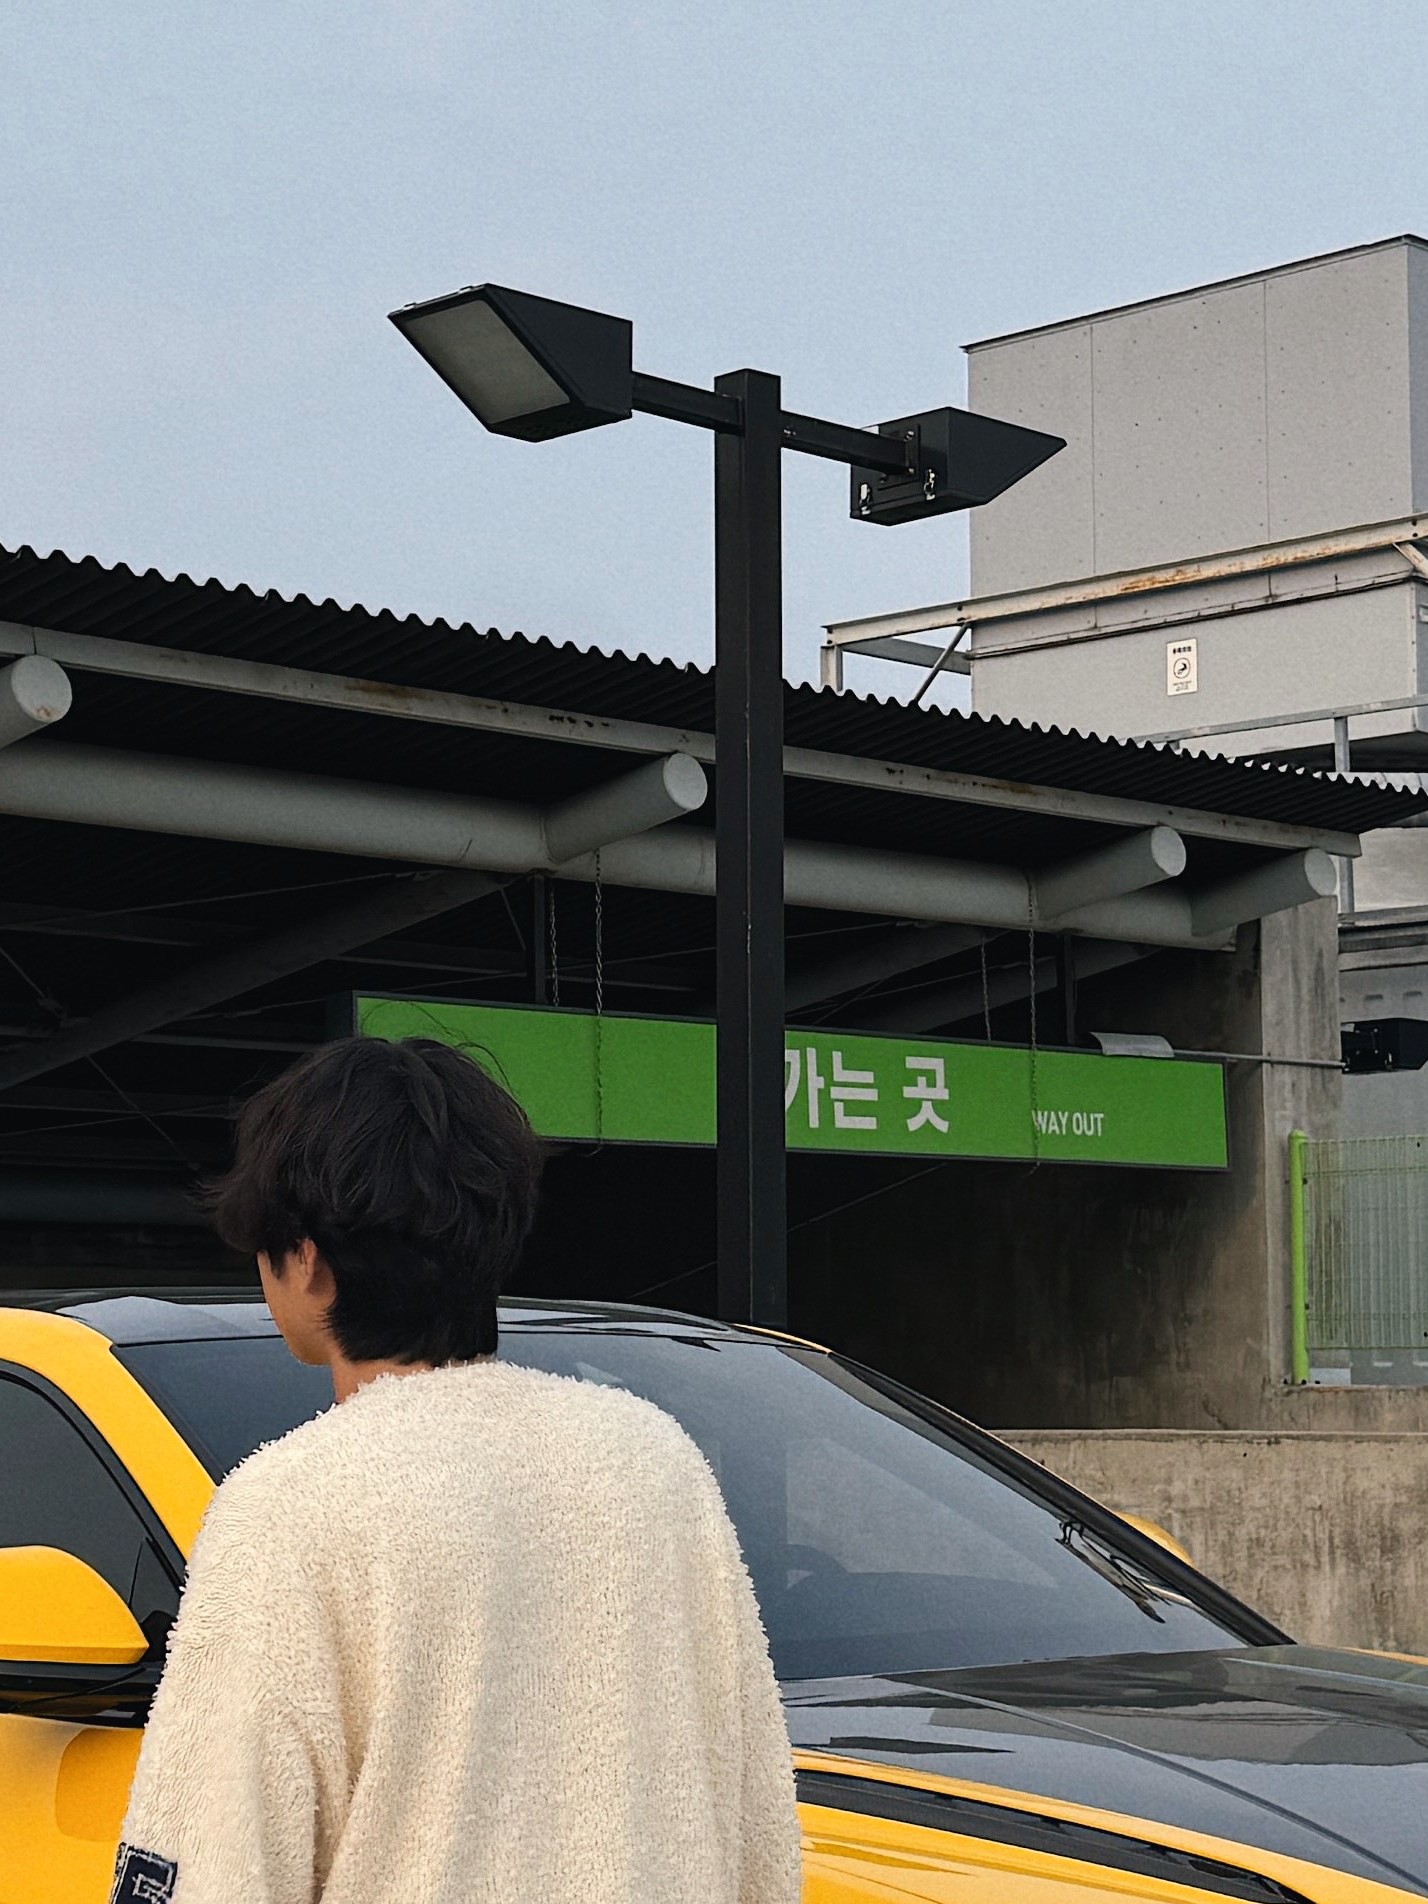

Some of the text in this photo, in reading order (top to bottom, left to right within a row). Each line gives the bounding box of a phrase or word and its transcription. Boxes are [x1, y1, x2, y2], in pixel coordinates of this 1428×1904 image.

[785, 1047, 950, 1134] 가는 곳
[1032, 1109, 1105, 1137] WAY OUT
